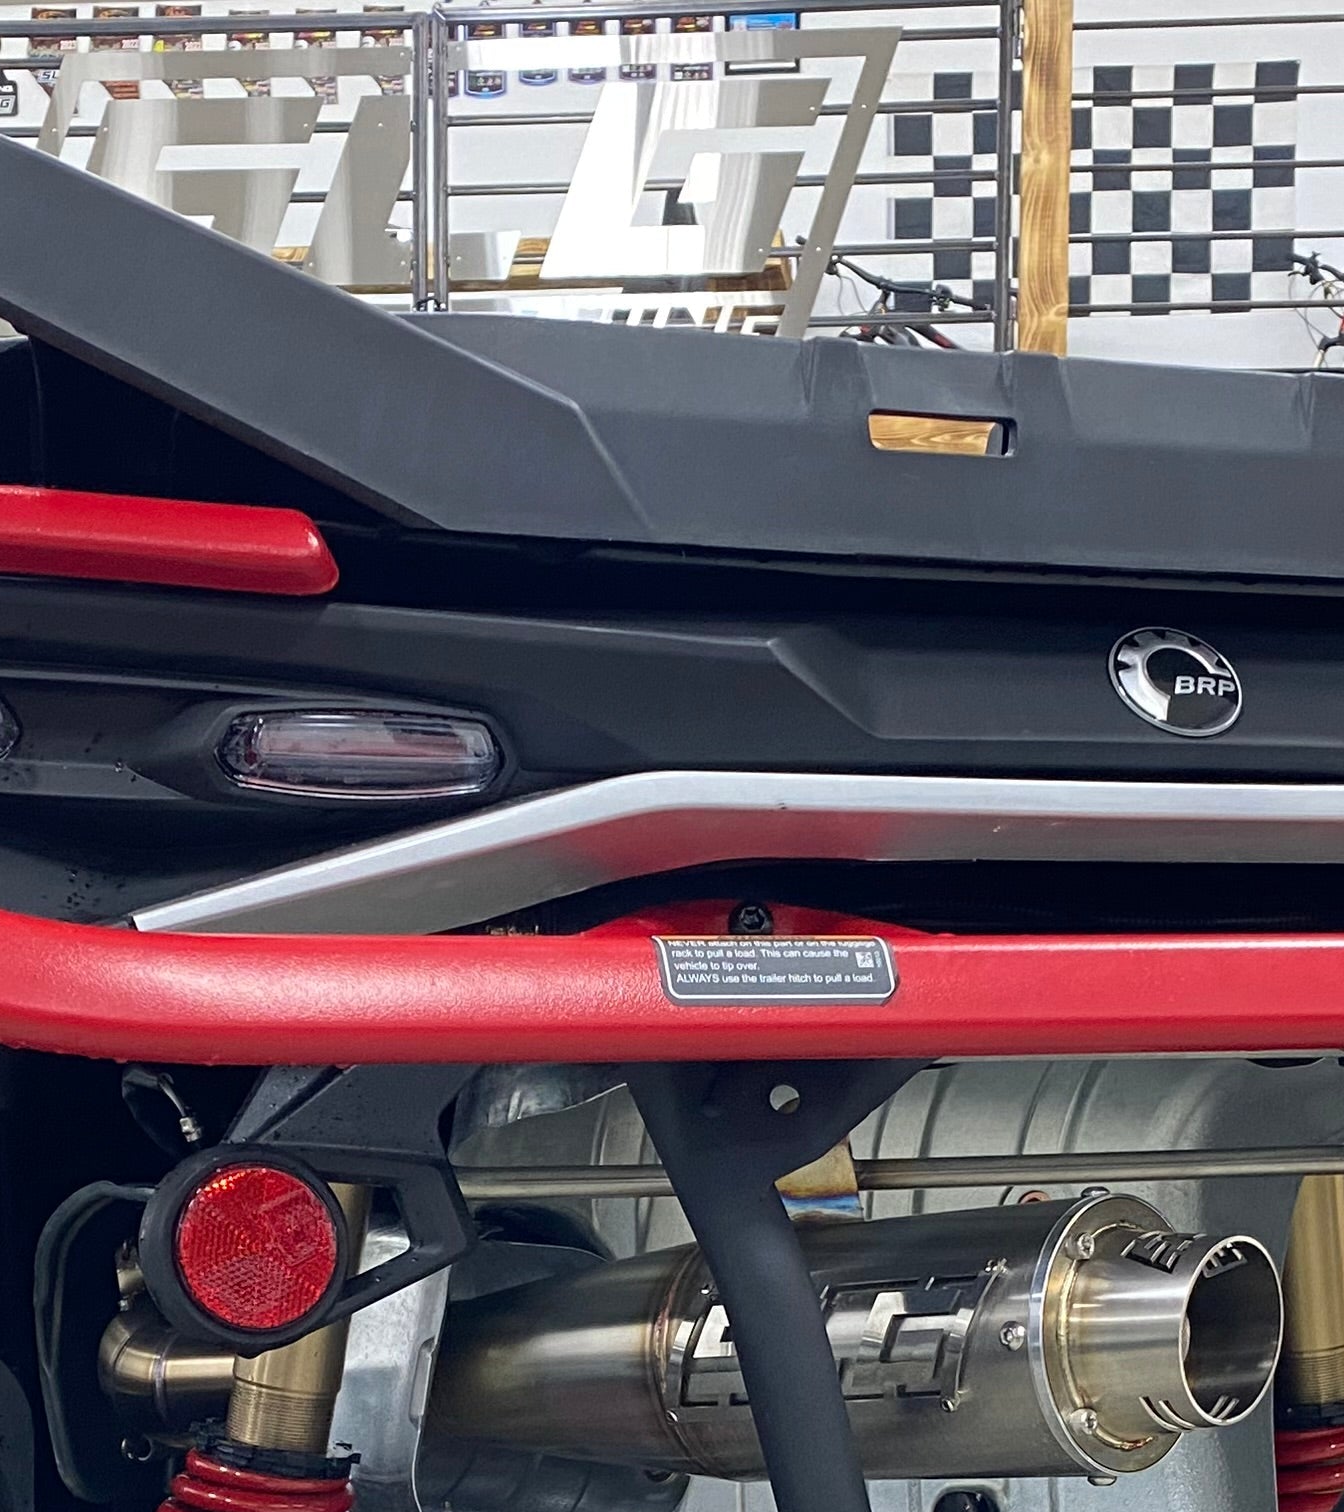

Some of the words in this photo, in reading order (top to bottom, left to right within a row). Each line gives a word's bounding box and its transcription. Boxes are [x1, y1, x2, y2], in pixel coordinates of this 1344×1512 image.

[1174, 675, 1236, 697] BRP
[671, 949, 693, 958] rack
[695, 949, 704, 958] to
[707, 949, 724, 959] pull
[760, 949, 781, 958] This
[783, 950, 800, 958] can
[803, 950, 831, 958] cause
[833, 949, 849, 958] the
[674, 961, 708, 970] vehicle
[710, 961, 720, 970] to
[722, 961, 734, 972] tip
[736, 962, 760, 971] over.
[676, 974, 719, 983] ALWAYS
[722, 975, 740, 983] use
[741, 974, 757, 983] the
[758, 974, 786, 983] trailer
[788, 974, 811, 983] hitch
[813, 974, 823, 983] to
[825, 974, 842, 984] pull
